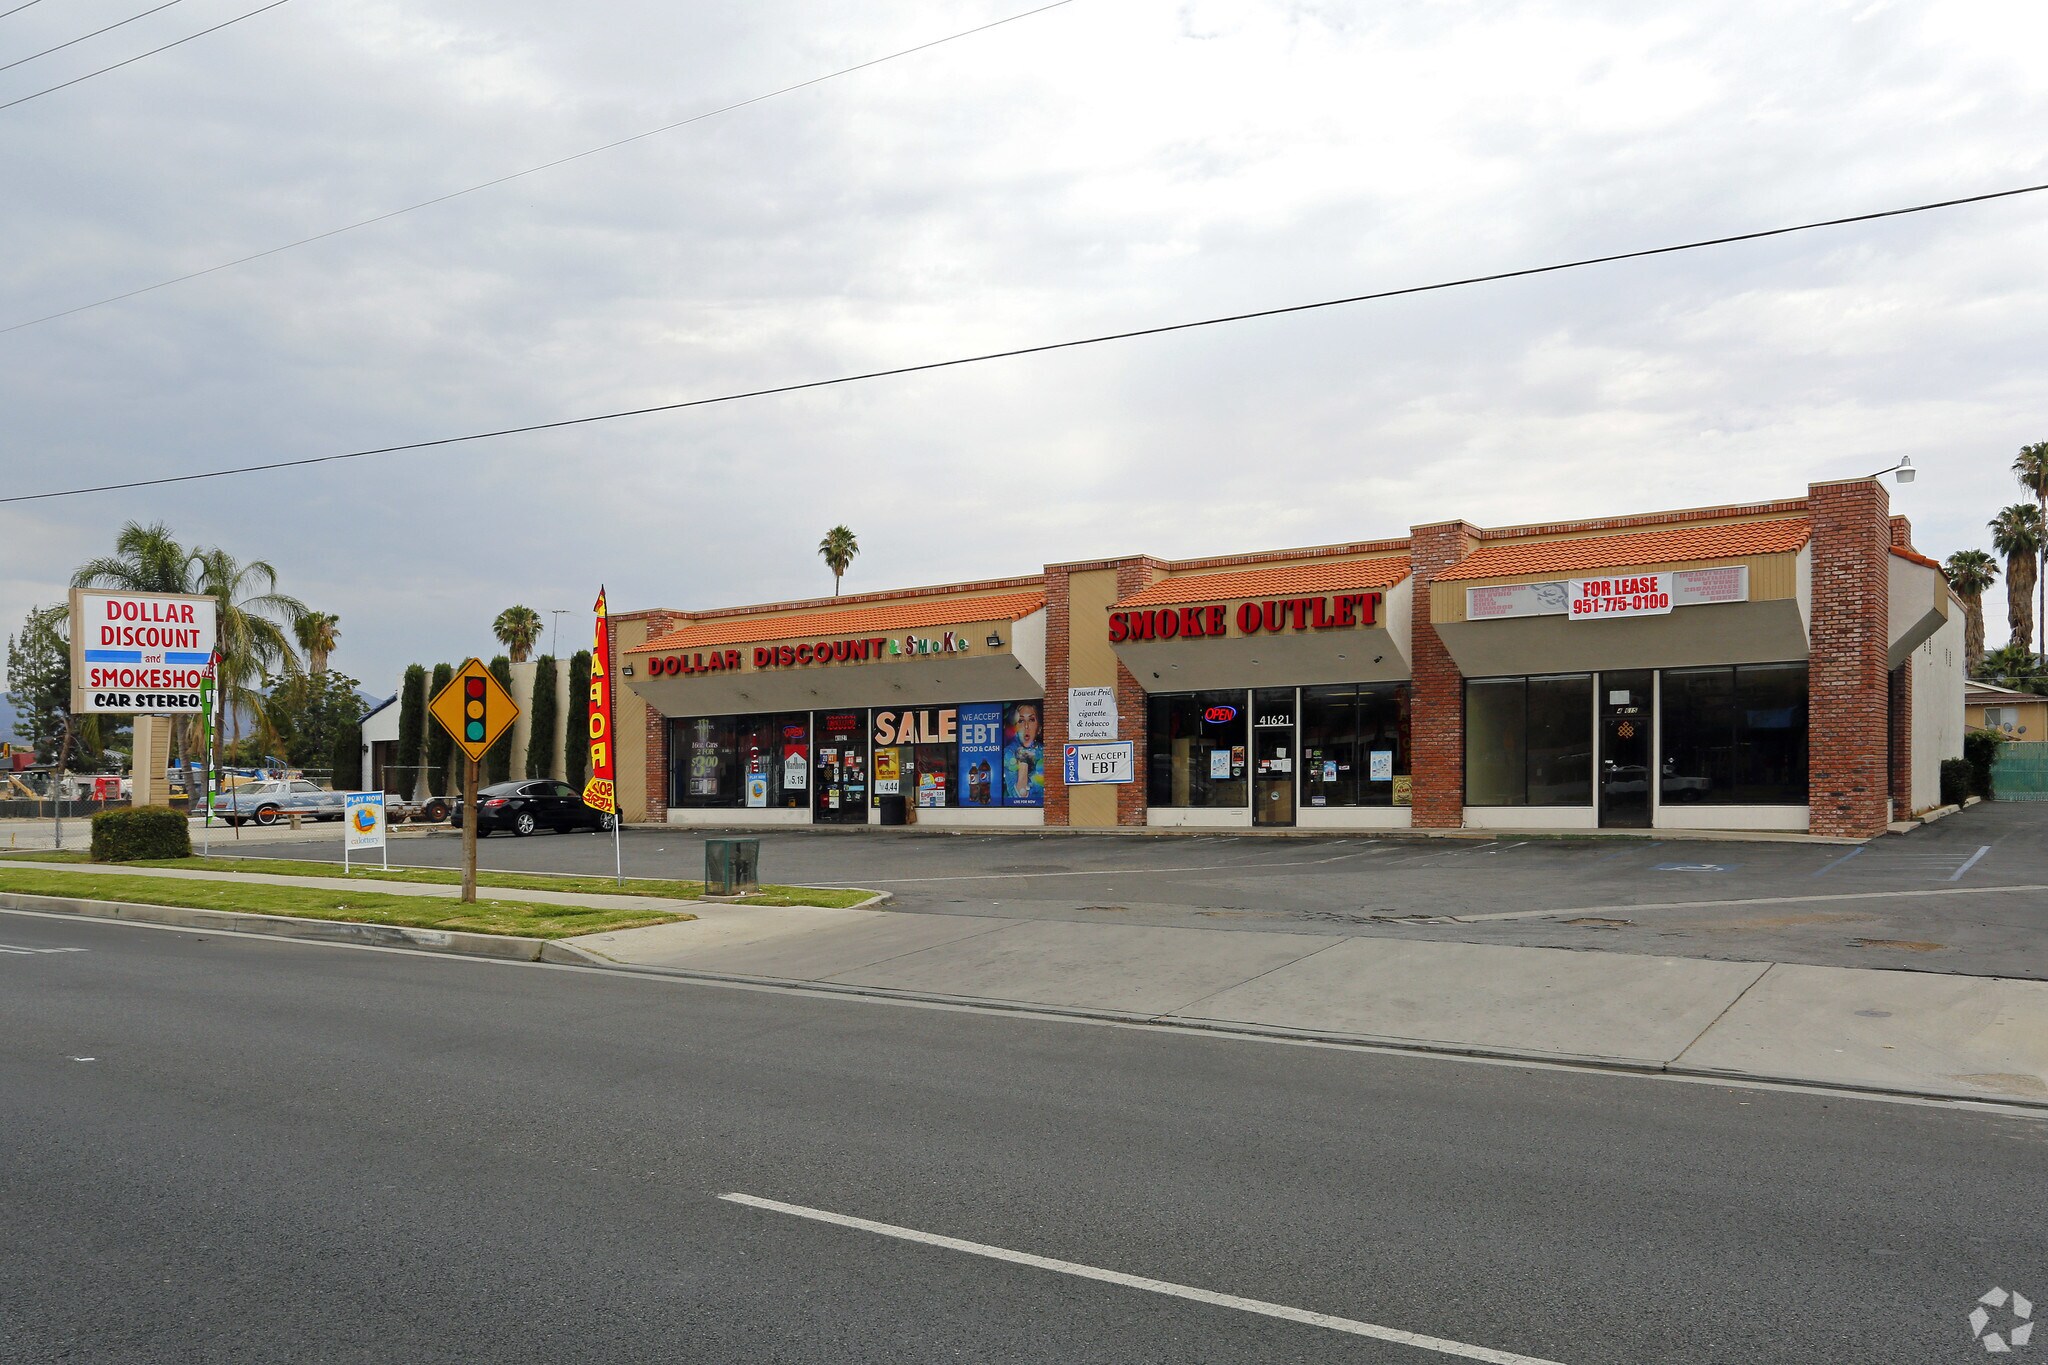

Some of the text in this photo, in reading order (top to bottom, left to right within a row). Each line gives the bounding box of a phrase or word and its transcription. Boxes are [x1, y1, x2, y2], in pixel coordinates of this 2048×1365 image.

[1583, 577, 1658, 597] FOR LEASE
[1573, 593, 1668, 614] 951-775-0100
[107, 600, 194, 623] DOLLAR
[1109, 592, 1382, 642] SMOKE OUTLET
[101, 625, 200, 648] DISCOUNT
[144, 653, 161, 663] and
[648, 649, 740, 675] DOLLAR
[753, 637, 885, 667] DISCOUNT
[889, 639, 901, 655] &
[90, 668, 201, 688] SMOKESHO
[1073, 688, 1112, 697] Lowest Pric
[94, 693, 203, 708] CAR STEREO
[962, 712, 1000, 721] WE ACCEPT
[1078, 710, 1106, 718] cigarette
[1205, 707, 1233, 721] OPEN
[1259, 714, 1290, 725] 41621
[784, 727, 804, 737] OPEN
[874, 709, 957, 745] SALE
[961, 723, 1000, 744] EBT
[1079, 730, 1107, 738] products
[1095, 751, 1127, 760] ACCEPT
[1068, 759, 1076, 782] pepsi
[1092, 761, 1117, 774] EBT
[791, 775, 804, 785] 5.19
[884, 783, 898, 791] 4.44
[351, 837, 378, 845] calottery
